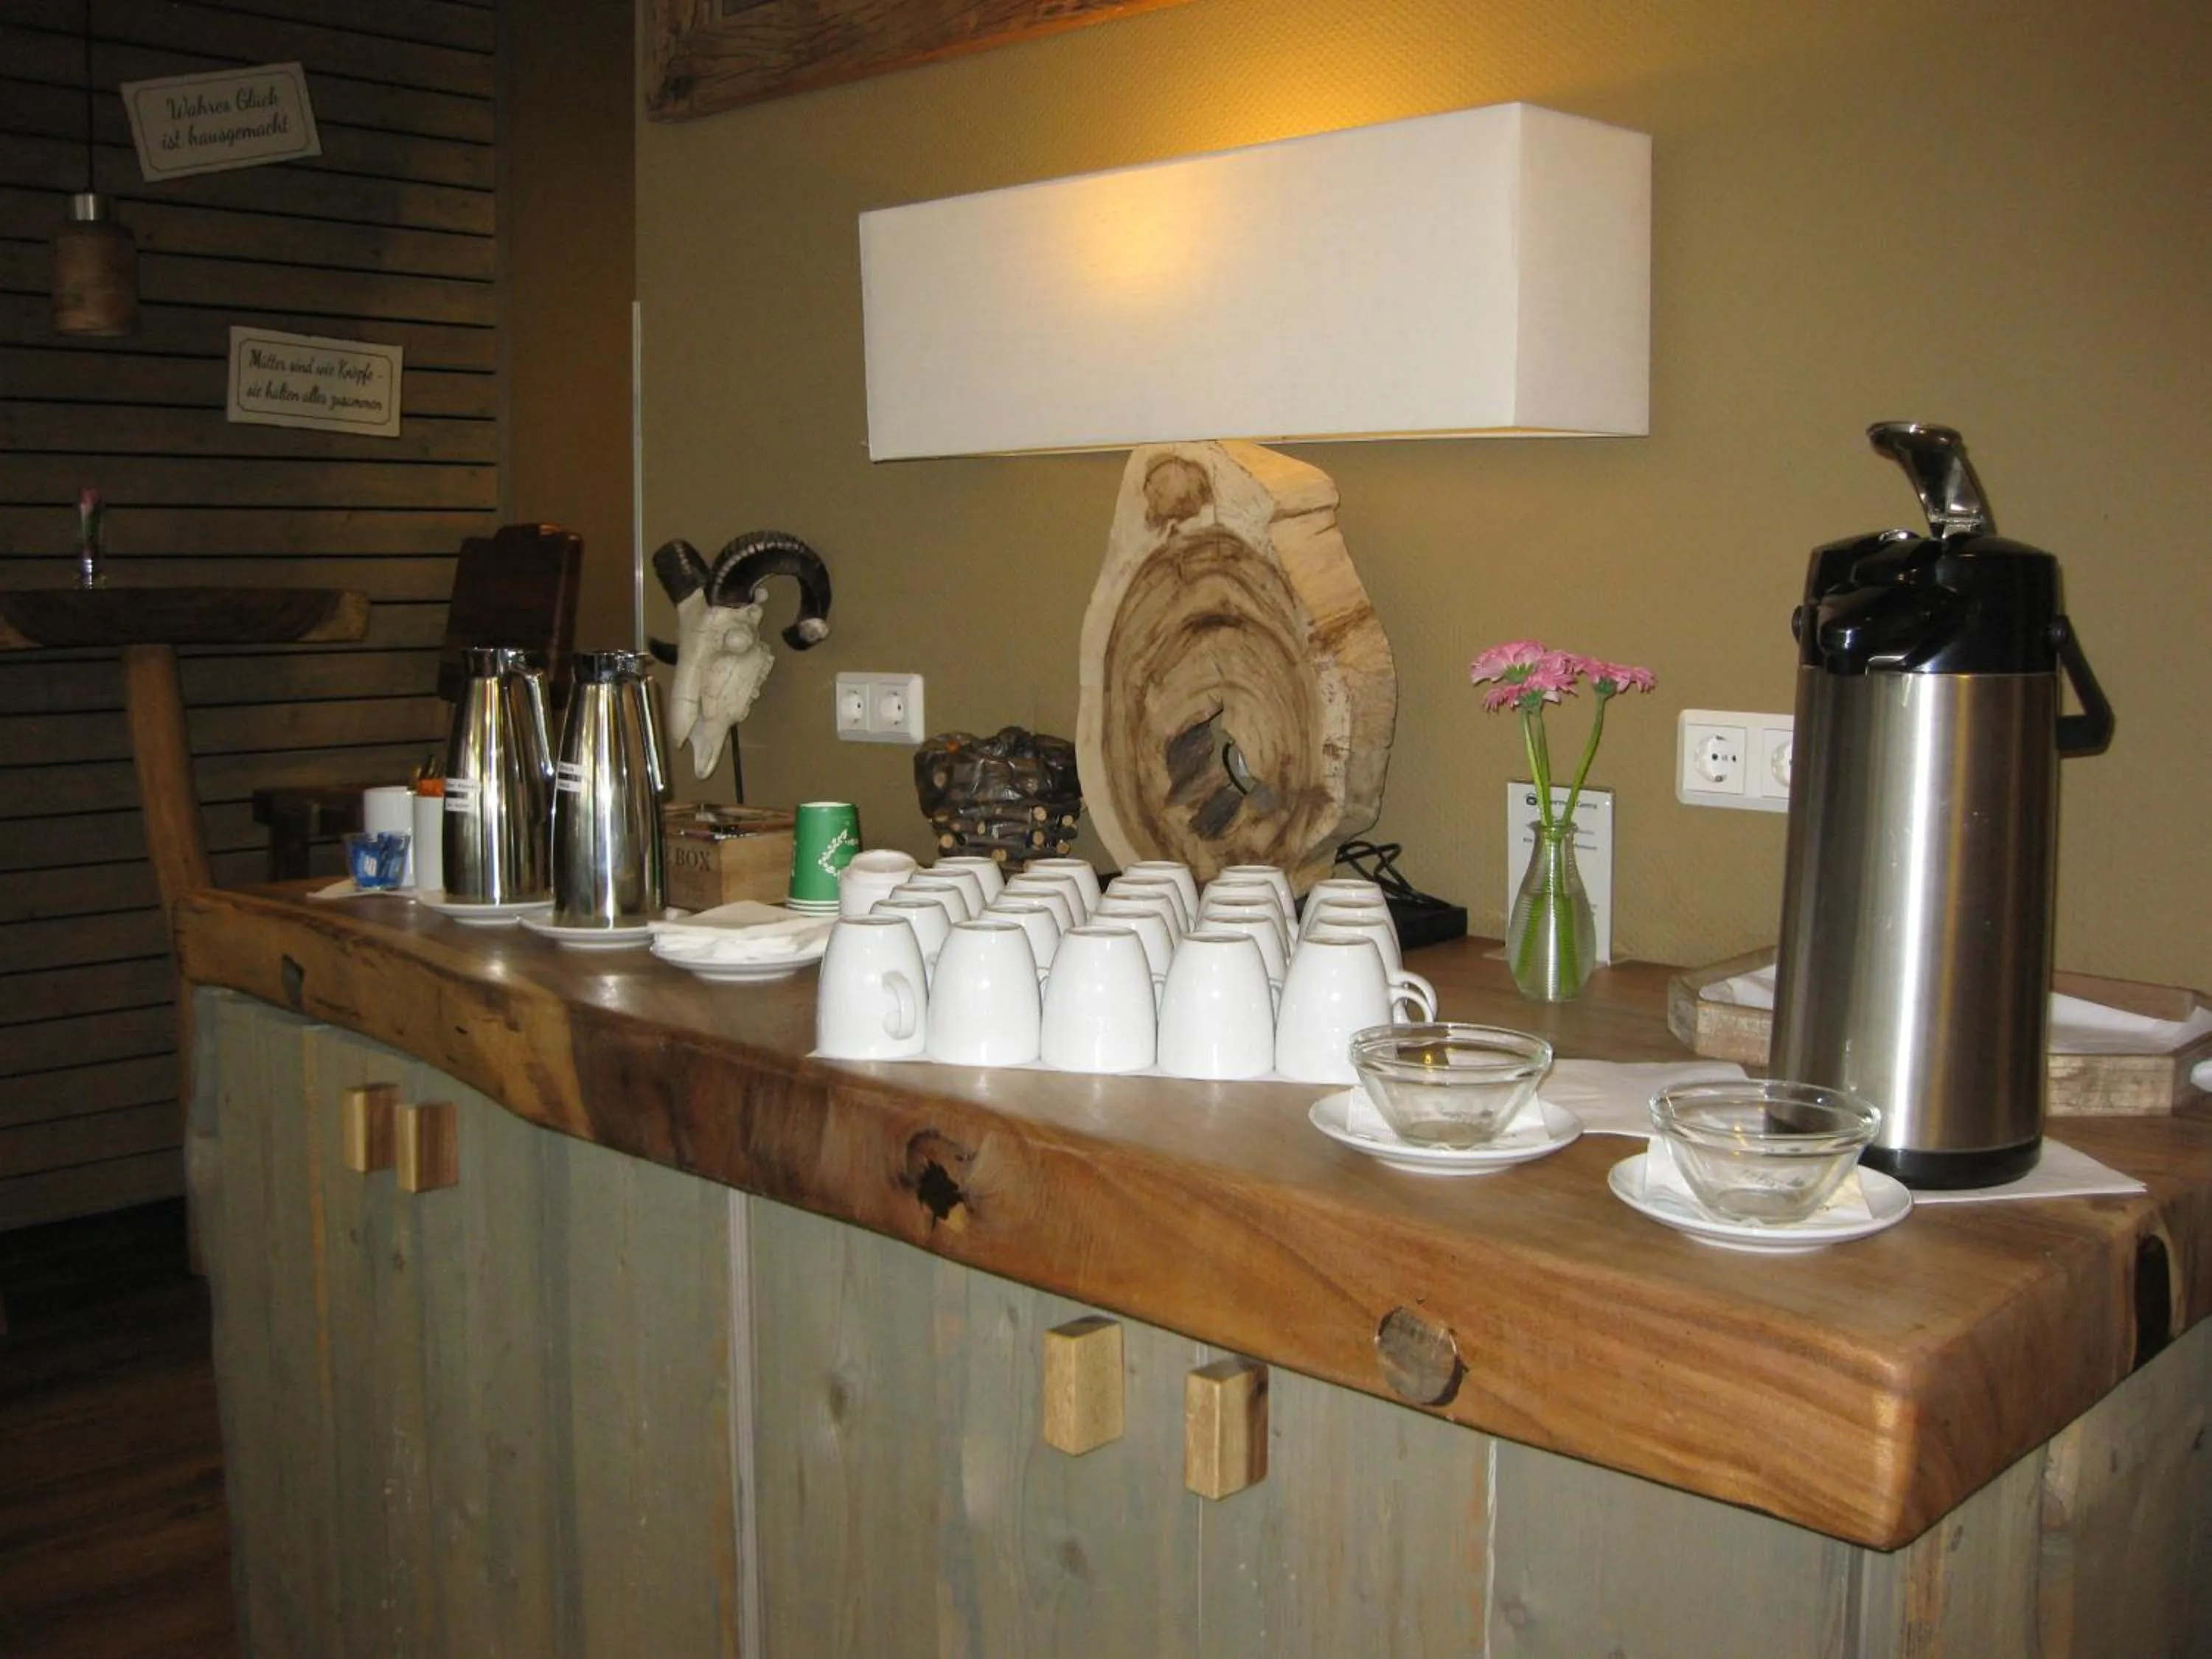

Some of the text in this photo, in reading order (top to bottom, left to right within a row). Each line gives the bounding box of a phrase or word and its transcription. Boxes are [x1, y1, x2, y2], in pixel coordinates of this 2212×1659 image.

[161, 111, 289, 150] ist hausgemacht
[265, 380, 299, 402] halten
[675, 847, 711, 872] BOX
